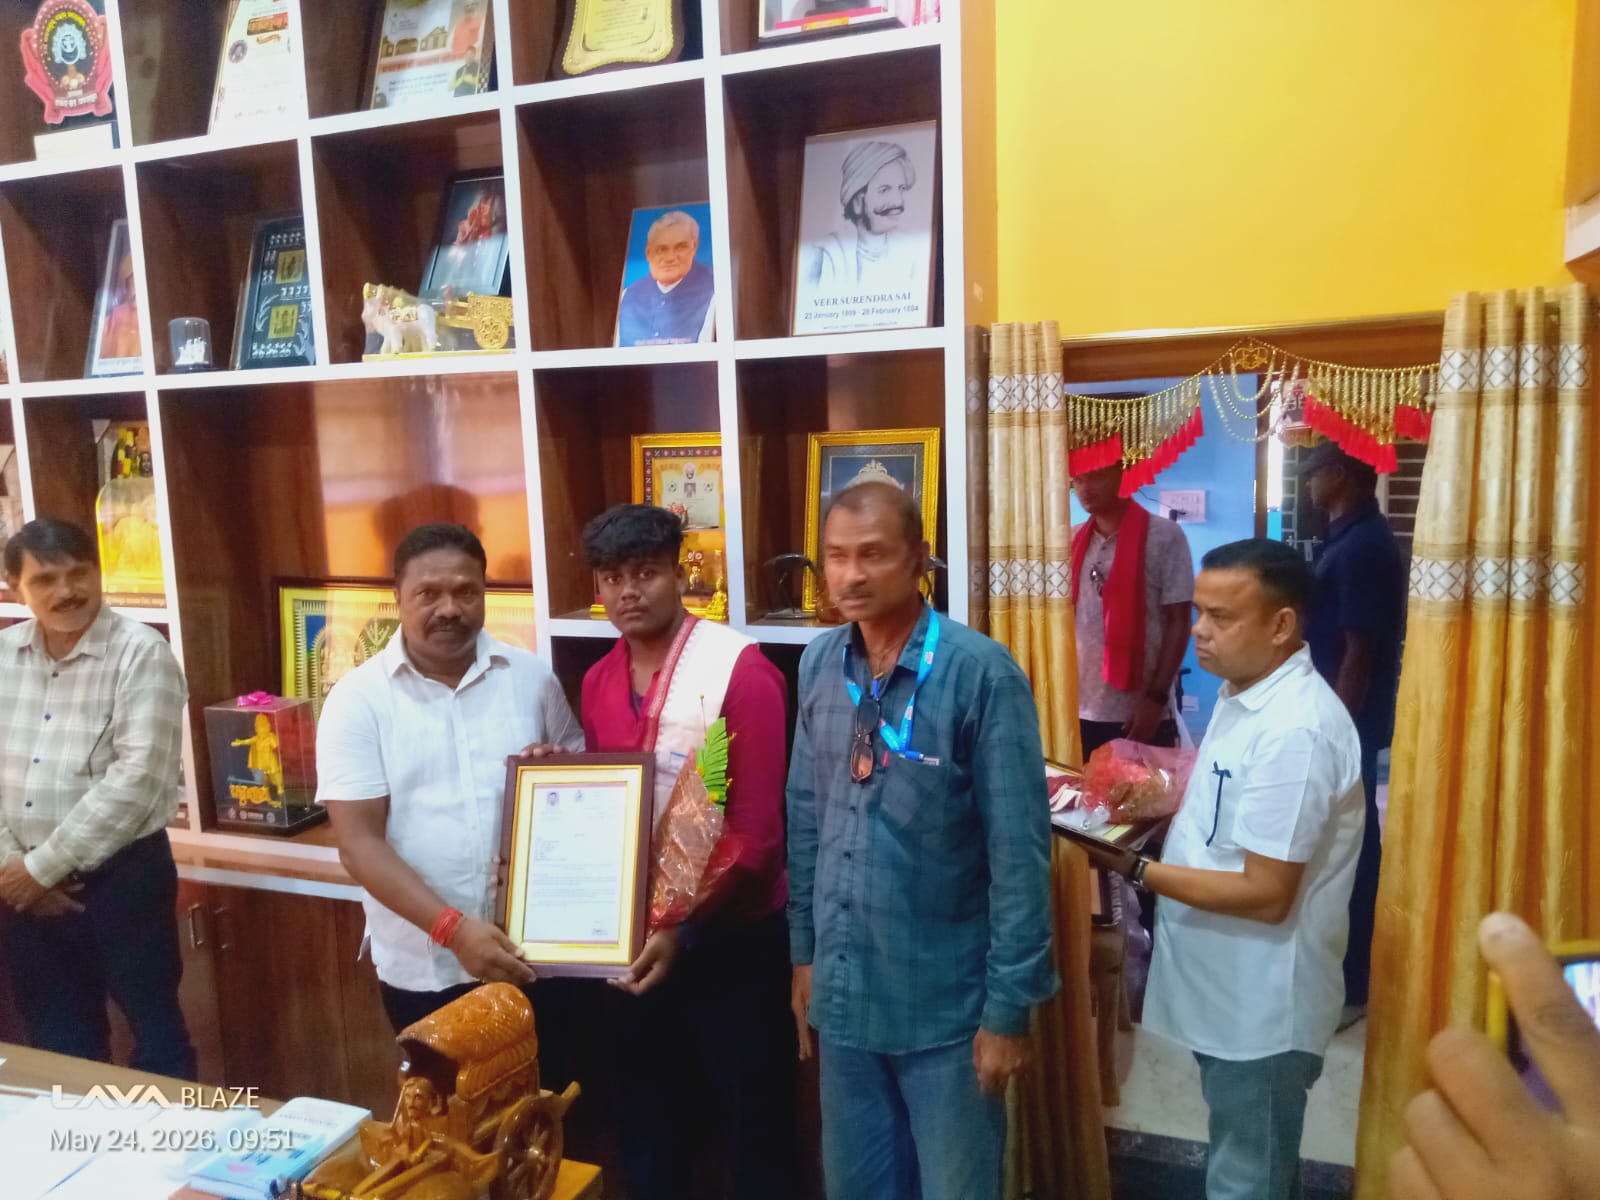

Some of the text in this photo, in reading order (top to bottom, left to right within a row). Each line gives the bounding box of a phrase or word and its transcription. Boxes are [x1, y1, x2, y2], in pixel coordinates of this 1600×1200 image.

[814, 292, 911, 307] VEER SURENDRA SAI
[814, 309, 839, 319] January
[871, 306, 901, 315] February
